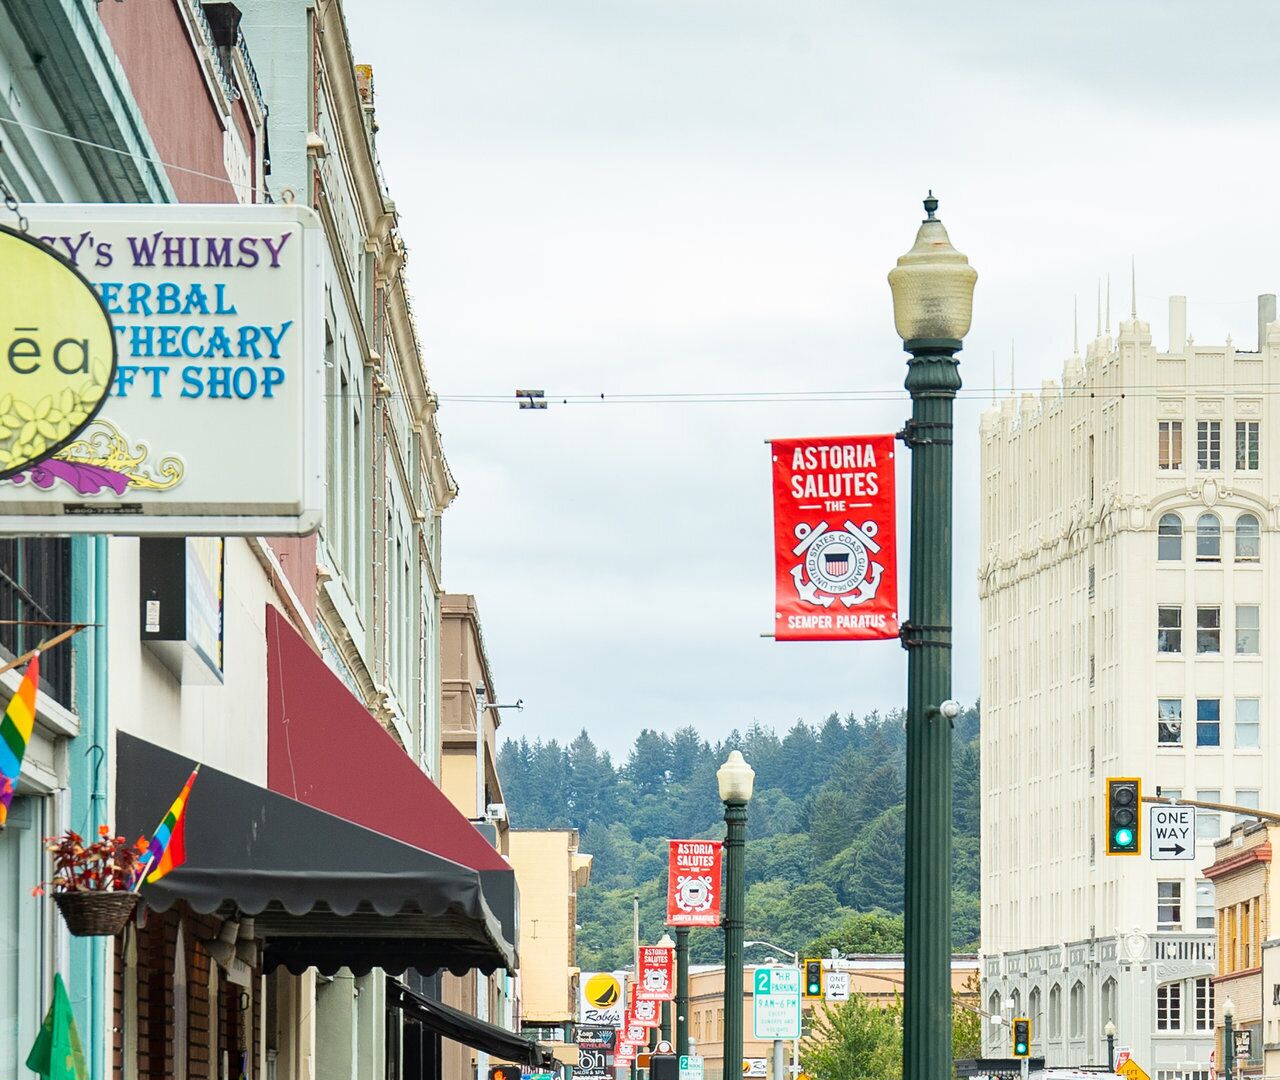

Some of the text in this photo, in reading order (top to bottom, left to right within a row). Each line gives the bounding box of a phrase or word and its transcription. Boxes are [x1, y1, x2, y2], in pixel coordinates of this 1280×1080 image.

[126, 230, 293, 269] WHIMSY
[90, 282, 238, 317] ERBAL
[180, 365, 286, 400] SHOP
[791, 444, 877, 471] ASTORIA
[791, 472, 879, 499] SALUTES
[824, 500, 847, 512] THE
[808, 534, 866, 590] UNITED STATES COAST GUARD
[788, 613, 887, 629] SEMPER PARATUS
[1157, 811, 1189, 825] ONE
[1155, 826, 1190, 841] WAY
[677, 843, 714, 855] ASTORIA
[676, 855, 715, 867] SALUTES
[758, 973, 769, 991] 2
[772, 983, 798, 992] PARKING
[585, 1009, 620, 1023] Roby's
[681, 1058, 688, 1068] 2
